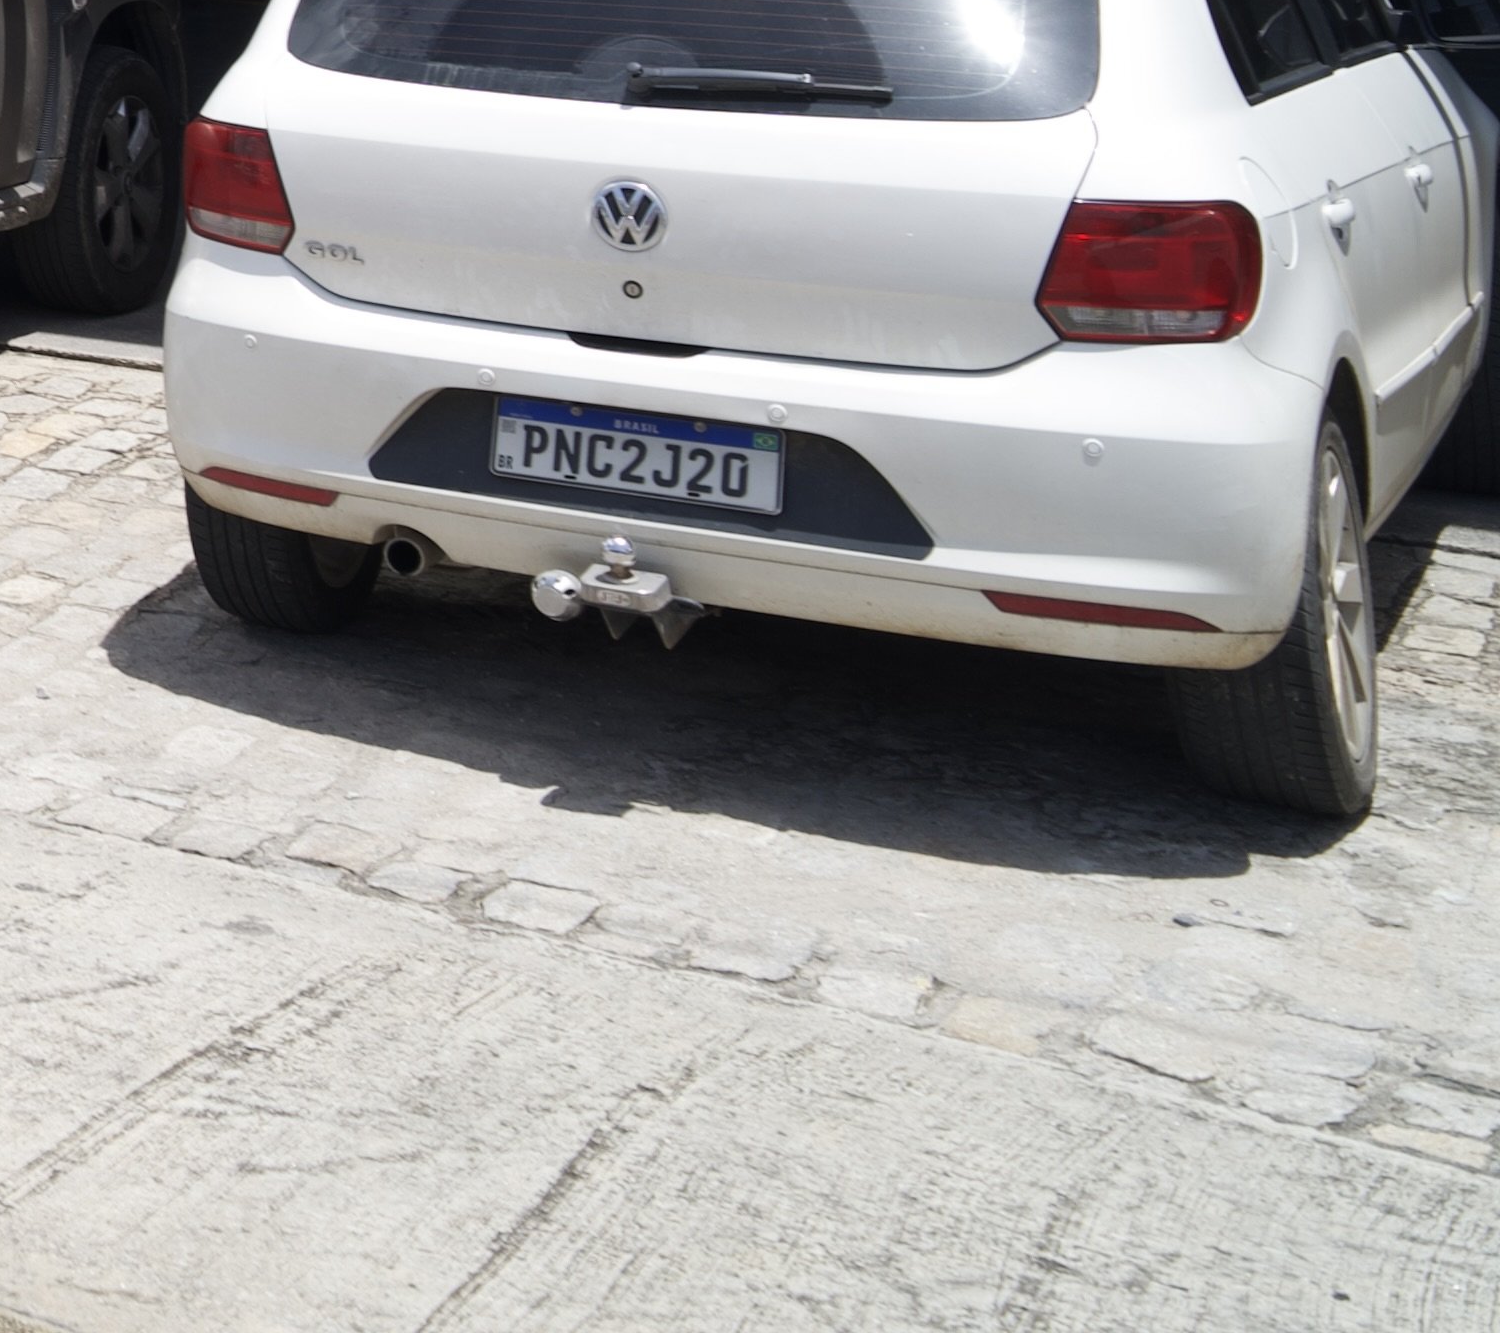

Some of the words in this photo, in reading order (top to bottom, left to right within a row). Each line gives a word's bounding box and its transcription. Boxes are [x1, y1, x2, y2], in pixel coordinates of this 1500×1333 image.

[304, 239, 366, 266] GOL
[613, 418, 660, 434] BRASIL
[523, 424, 749, 499] PNC2J20
